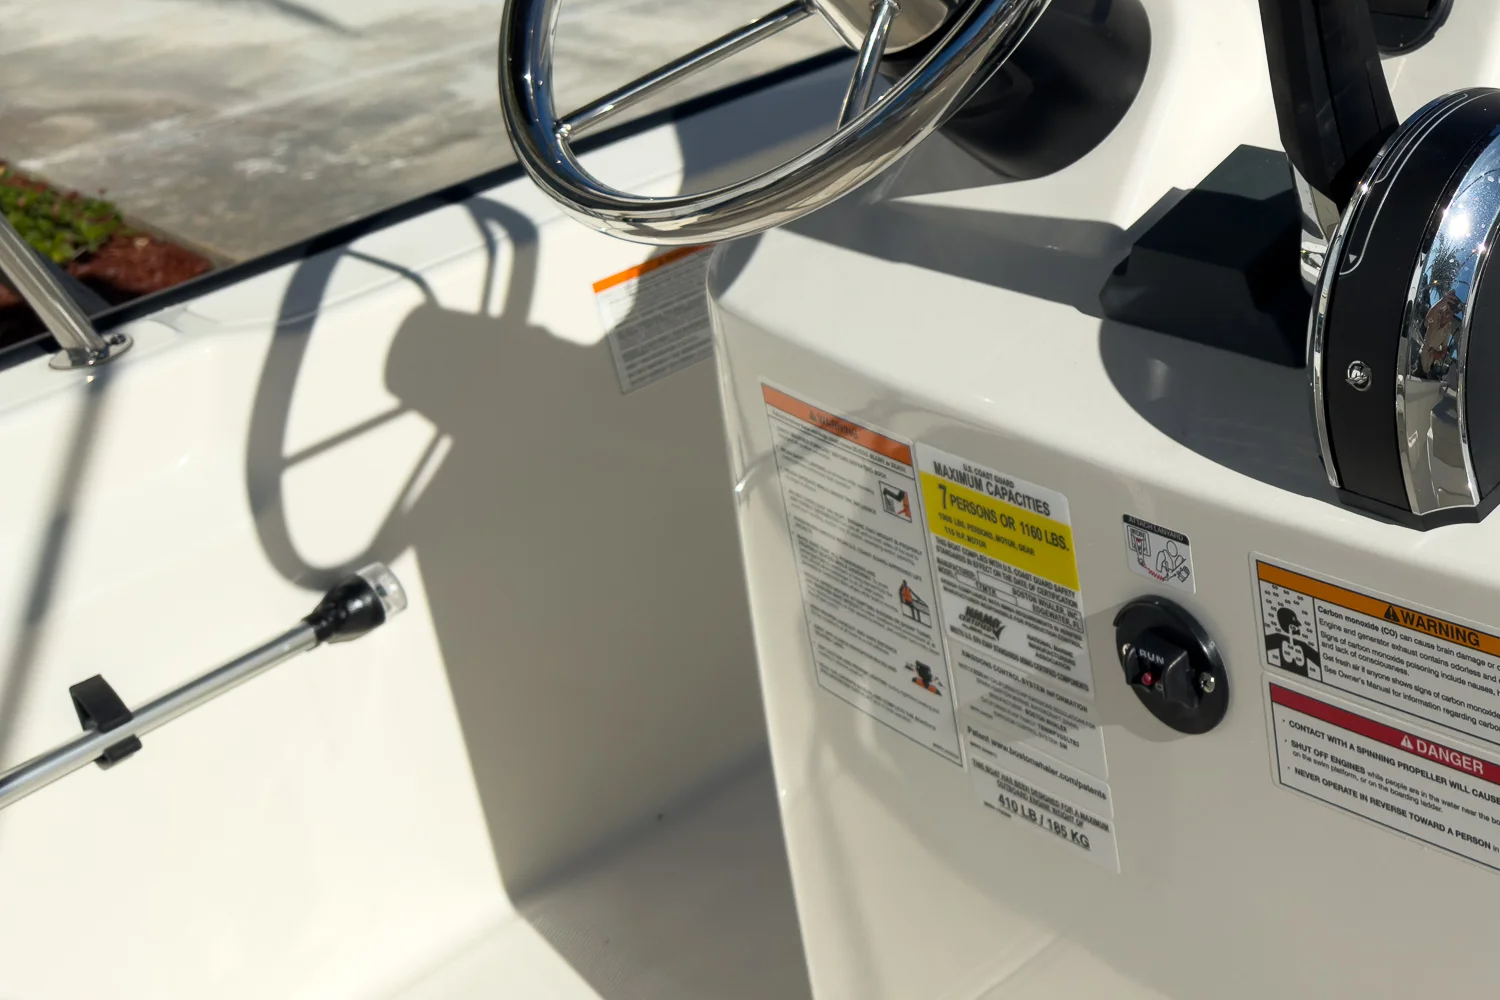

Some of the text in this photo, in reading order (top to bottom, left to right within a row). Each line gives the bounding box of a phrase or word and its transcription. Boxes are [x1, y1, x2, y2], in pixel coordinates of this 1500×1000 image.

[816, 413, 860, 440] WARNING
[933, 460, 1050, 516] MAXIMUM CAPACITIES
[973, 468, 992, 480] COAST
[993, 475, 1014, 488] GUARD
[937, 483, 1069, 551] 7 PERSONS OR 1160 LBS.
[1128, 515, 1184, 542] ATTACH LANYARD
[1139, 649, 1165, 665] RUN
[1317, 605, 1343, 620] Carbon
[1344, 615, 1379, 631] monoxide
[1380, 626, 1398, 639] (CO)
[1398, 633, 1412, 642] can
[1413, 638, 1435, 650] cause
[1436, 643, 1454, 656] brain
[1455, 651, 1485, 666] damage
[1318, 617, 1342, 631] Engine
[1342, 627, 1356, 636] and
[1357, 631, 1389, 647] generator
[1390, 643, 1418, 657] exhaust
[1418, 652, 1449, 667] contains
[1450, 662, 1481, 677] odorless
[1482, 672, 1496, 682] and
[1321, 640, 1334, 650] and
[1334, 644, 1349, 655] lack
[1357, 653, 1409, 676] consciousness.
[1400, 609, 1479, 647] WARNING
[1320, 630, 1338, 642] Signs
[1347, 640, 1370, 653] carbon
[1371, 649, 1404, 665] monoxide
[1405, 660, 1439, 678] poisoning
[1440, 670, 1466, 685] include
[1467, 680, 1495, 696] nausea,
[1322, 652, 1334, 662] Get
[1334, 656, 1351, 668] fresh
[1366, 668, 1390, 681] anyone
[1391, 677, 1413, 689] shows
[1413, 684, 1432, 696] signs
[1440, 694, 1465, 707] carbon
[1466, 702, 1500, 719] monoxide
[1323, 664, 1336, 675] See
[1337, 669, 1365, 685] Owner's
[1365, 679, 1390, 694] Manual
[1391, 688, 1401, 697] for
[1402, 691, 1441, 711] information
[1442, 707, 1476, 725] regarding
[1288, 719, 1325, 739] CONTACT
[1326, 733, 1347, 748] WITH
[1356, 745, 1395, 766] SPINNING
[1397, 760, 1447, 785] PROPELLER
[1448, 779, 1470, 794] WILL
[1290, 739, 1311, 753] SHUT
[1313, 748, 1328, 759] OFF
[1330, 754, 1365, 774] ENGINES
[1366, 771, 1384, 781] while
[1384, 777, 1407, 790] people
[1408, 786, 1419, 795] are
[1428, 793, 1439, 803] the
[1440, 799, 1460, 810] water
[1461, 806, 1476, 816] near
[1478, 811, 1490, 821] the
[1301, 752, 1312, 762] the
[1312, 758, 1329, 769] swim
[1330, 764, 1358, 781] platform,
[1377, 782, 1388, 792] the
[1389, 787, 1419, 805] boarding
[1420, 798, 1442, 812] ladder.
[1416, 738, 1483, 774] DANGER
[998, 793, 1018, 813] 410
[1020, 804, 1037, 822] LB
[1039, 814, 1043, 826] /
[1070, 829, 1089, 849] KG
[1294, 766, 1320, 783] NEVER
[1321, 778, 1358, 798] OPERATE
[1359, 792, 1368, 802] IN
[1369, 796, 1407, 817] REVERSE
[1408, 811, 1445, 832] TOWARD
[1446, 827, 1453, 835] A
[1454, 829, 1491, 849] PERSON
[1492, 844, 1499, 852] in
